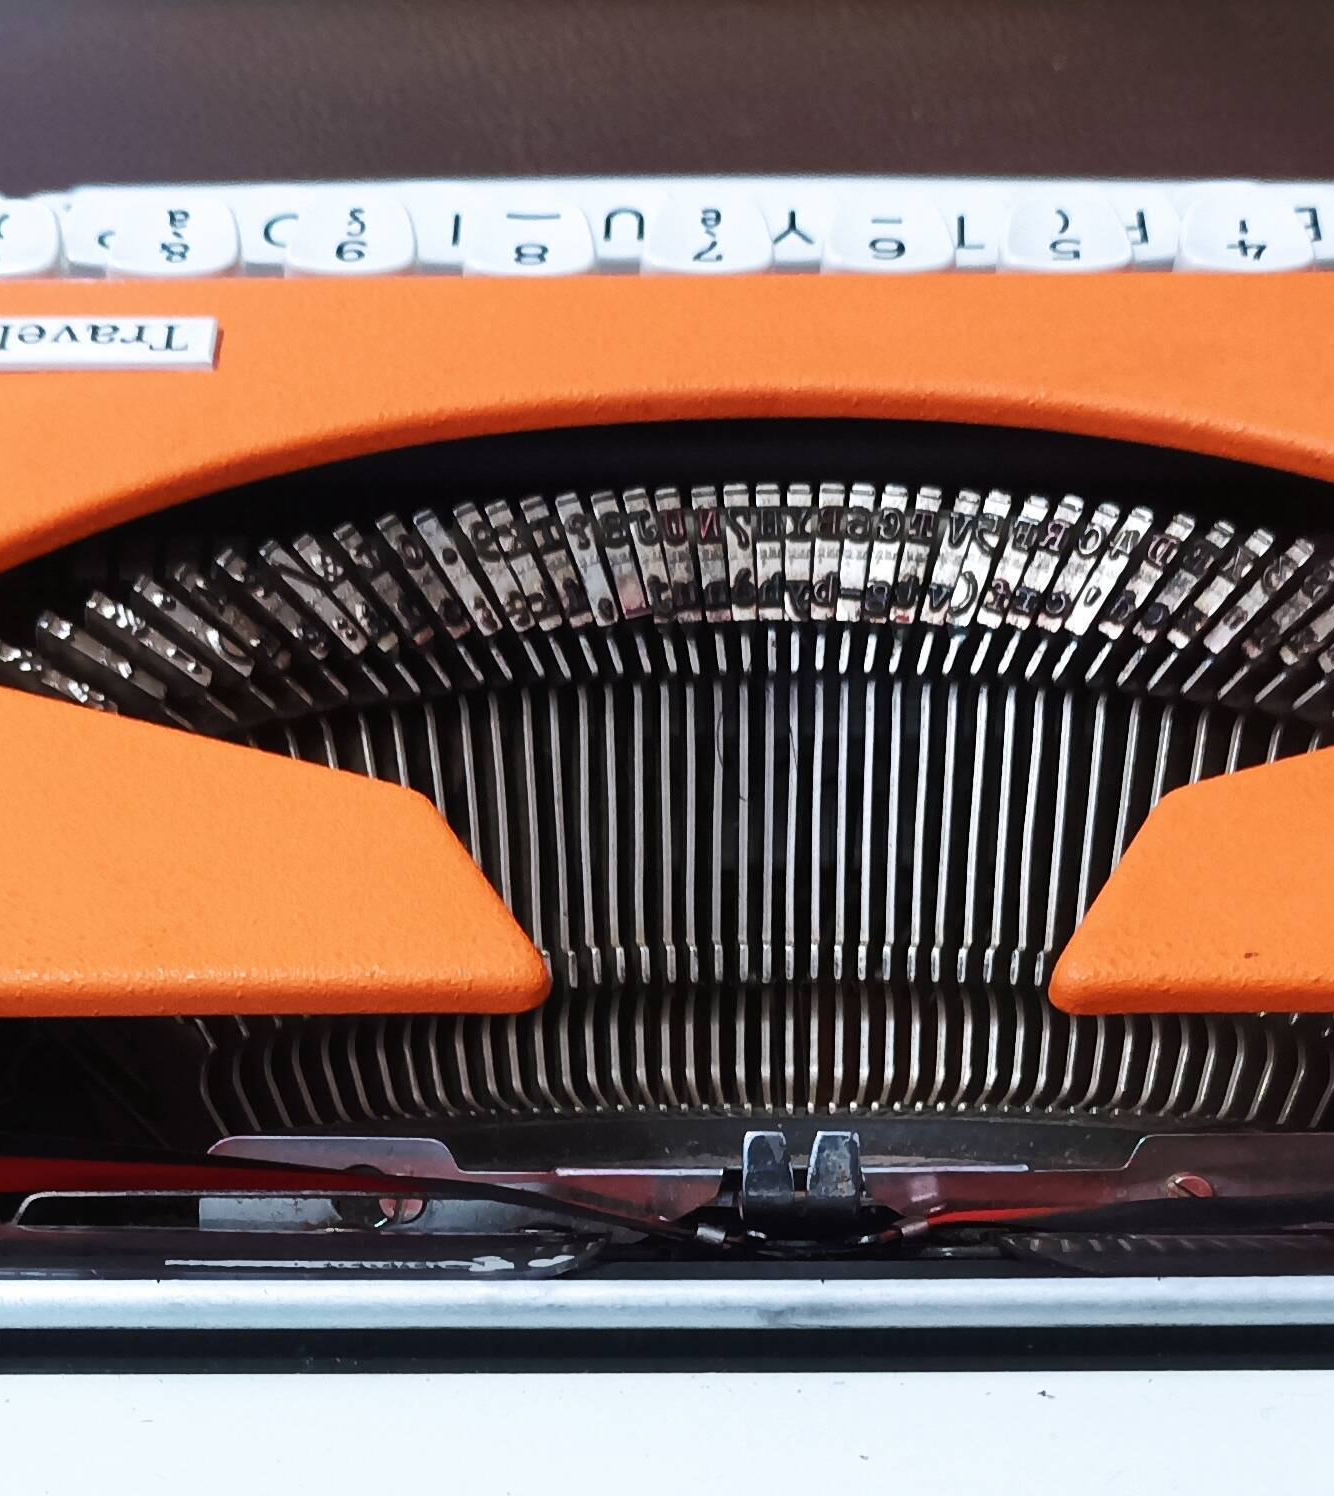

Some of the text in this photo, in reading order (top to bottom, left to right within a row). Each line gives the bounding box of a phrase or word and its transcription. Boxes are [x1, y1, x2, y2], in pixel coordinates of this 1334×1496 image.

[603, 207, 645, 242] U
[772, 209, 815, 245] Y
[514, 243, 549, 265] 8
[868, 238, 906, 260] 6
[1049, 239, 1081, 260] 5
[1226, 239, 1267, 261] 4
